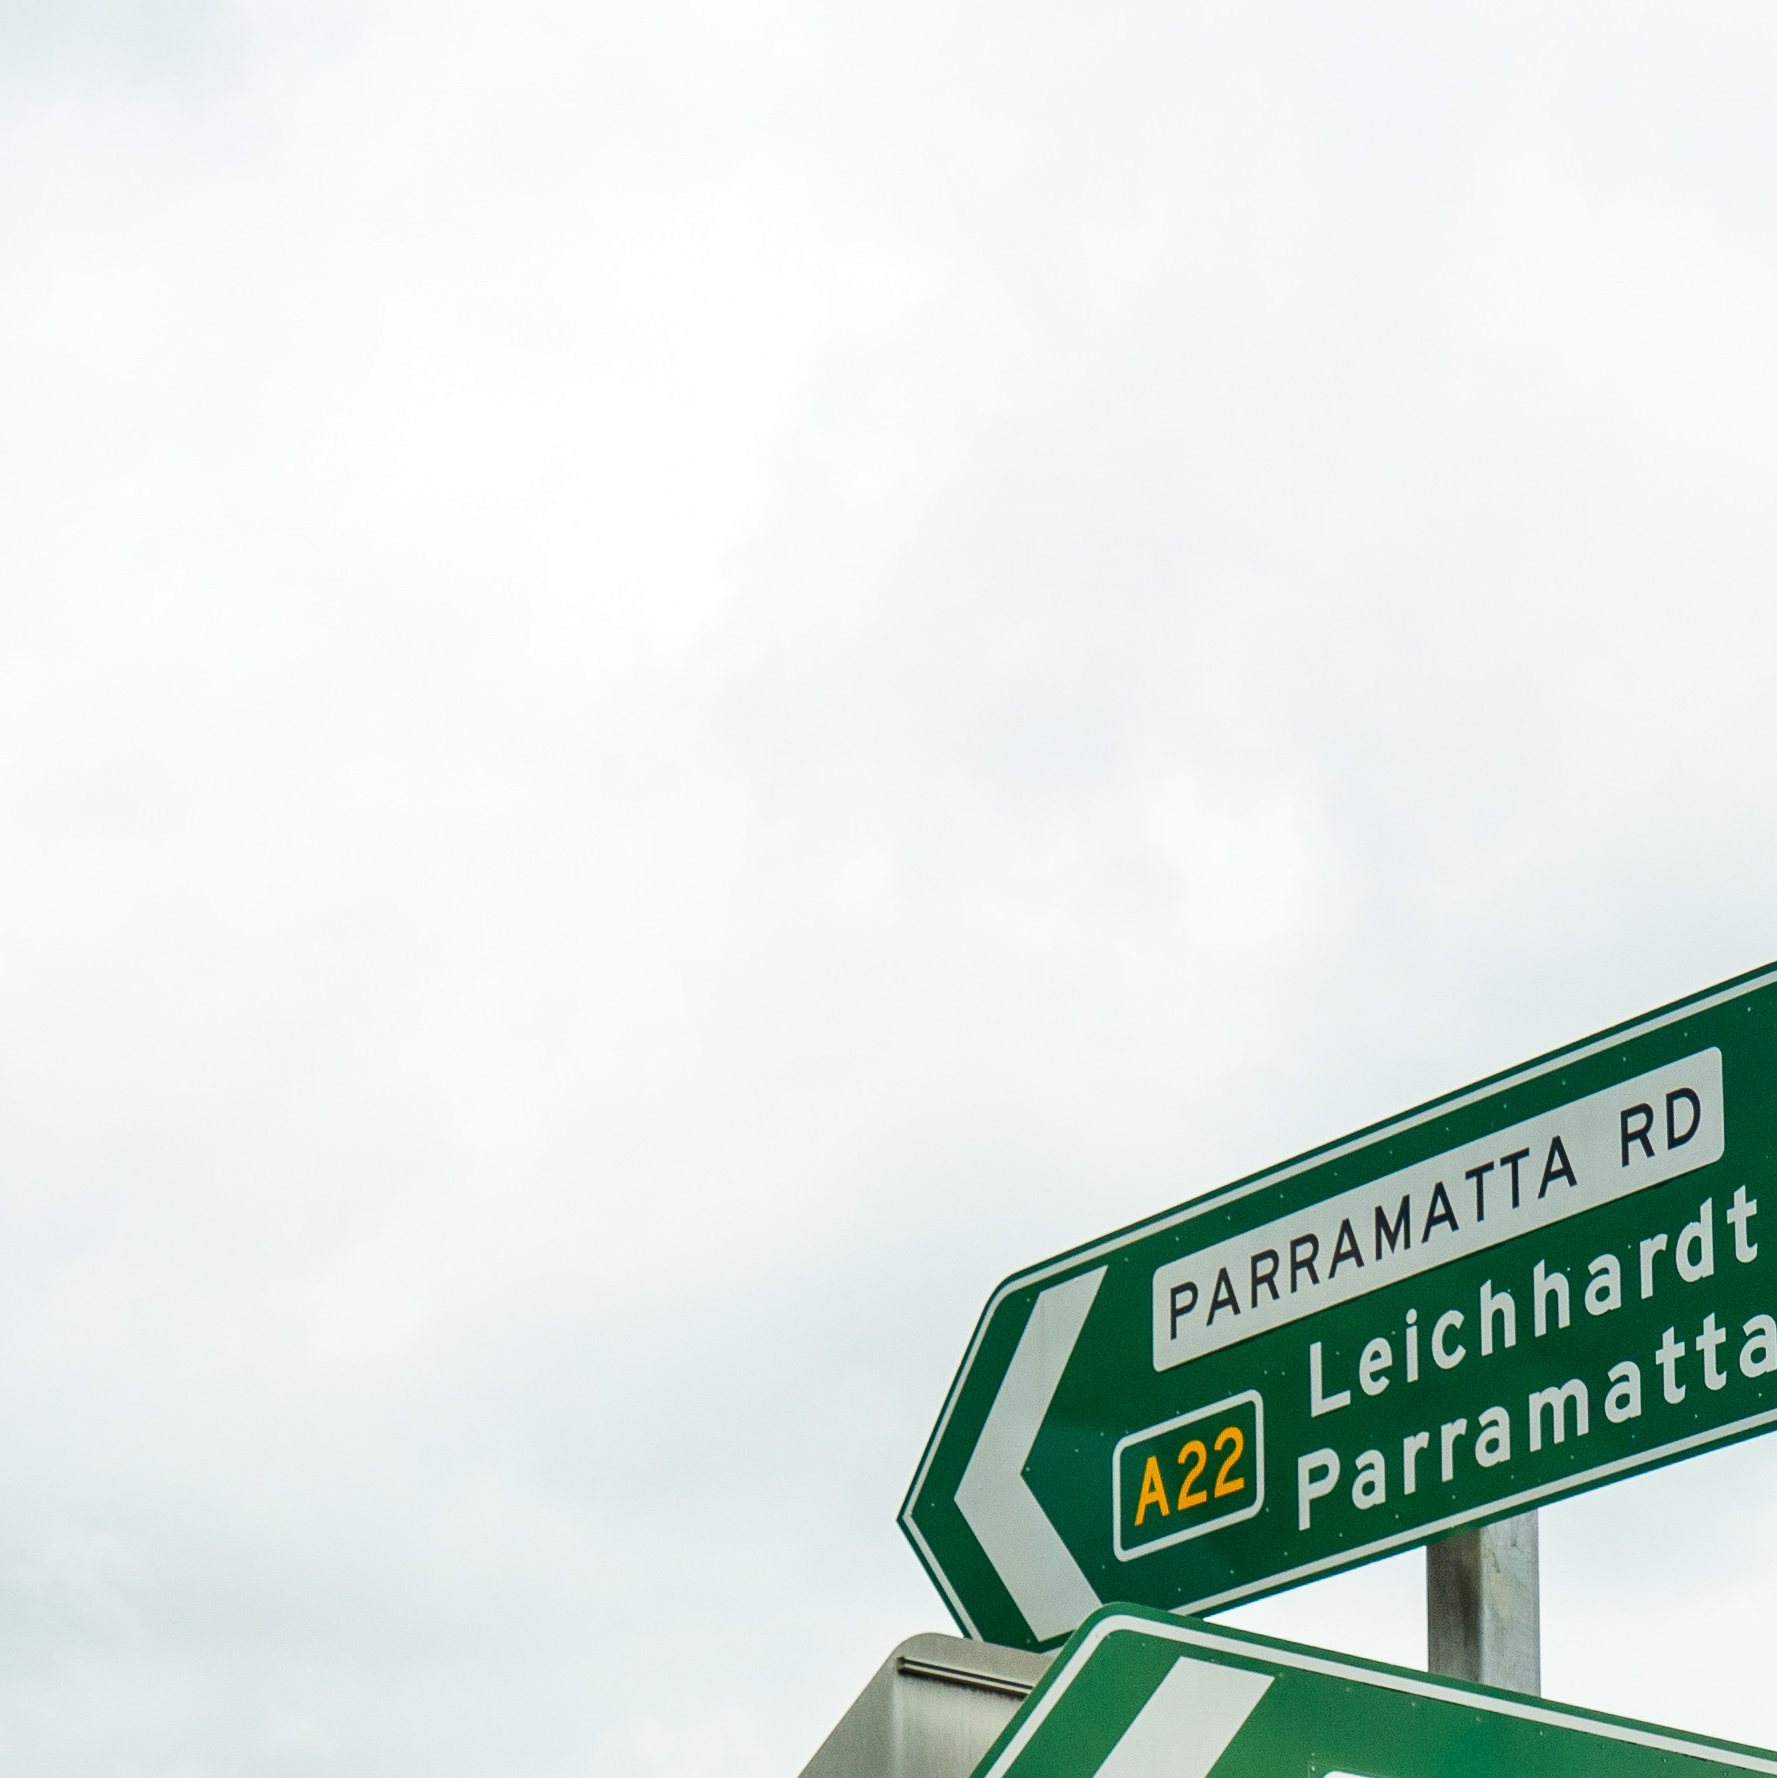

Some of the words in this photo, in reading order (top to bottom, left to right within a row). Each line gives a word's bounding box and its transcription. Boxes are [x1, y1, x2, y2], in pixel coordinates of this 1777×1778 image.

[1168, 1135, 1580, 1340] PARRAMATTA
[1620, 1086, 1704, 1167] RD
[1308, 1184, 1761, 1417] Leichhardt
[1133, 1425, 1247, 1527] A22
